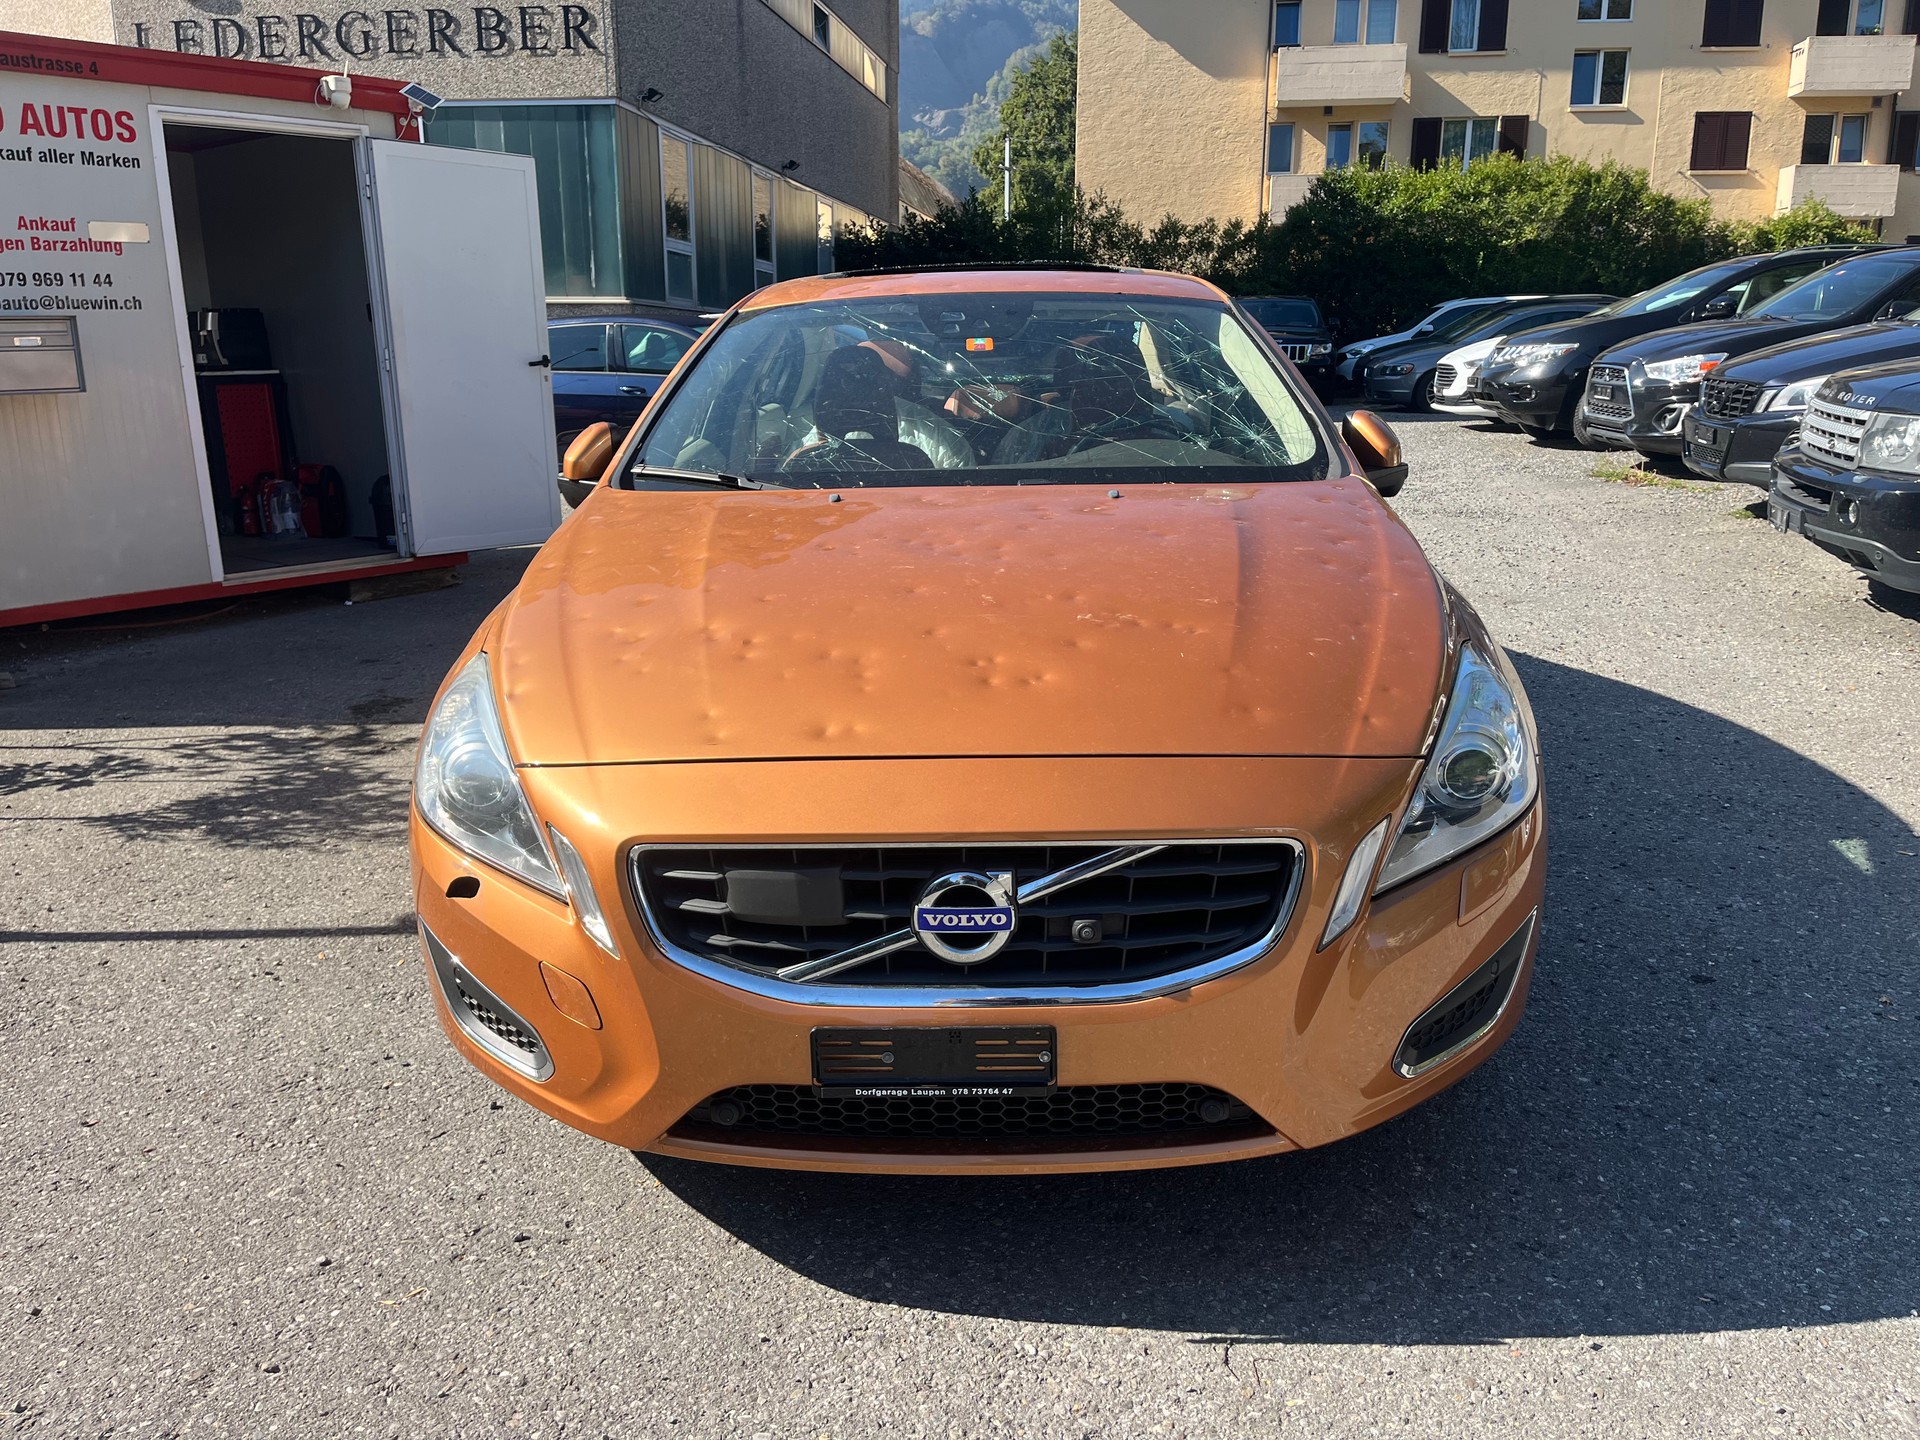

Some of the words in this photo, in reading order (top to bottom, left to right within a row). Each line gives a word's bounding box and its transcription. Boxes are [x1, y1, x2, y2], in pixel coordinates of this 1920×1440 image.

[89, 61, 99, 75] 4
[19, 102, 137, 143] AUTOS
[38, 148, 75, 165] aller
[80, 150, 141, 169] Marken
[17, 215, 76, 232] Ankauf
[30, 236, 123, 256] Barzahlung
[32, 272, 64, 287] 969
[69, 272, 86, 287] 11
[93, 273, 113, 287] 44
[0, 295, 142, 311] auto@bluewin.ch
[1837, 391, 1876, 405] ROVER
[922, 913, 1007, 926] VOLVO
[855, 1088, 908, 1097] Dorfgarage
[911, 1088, 946, 1097] Laupen
